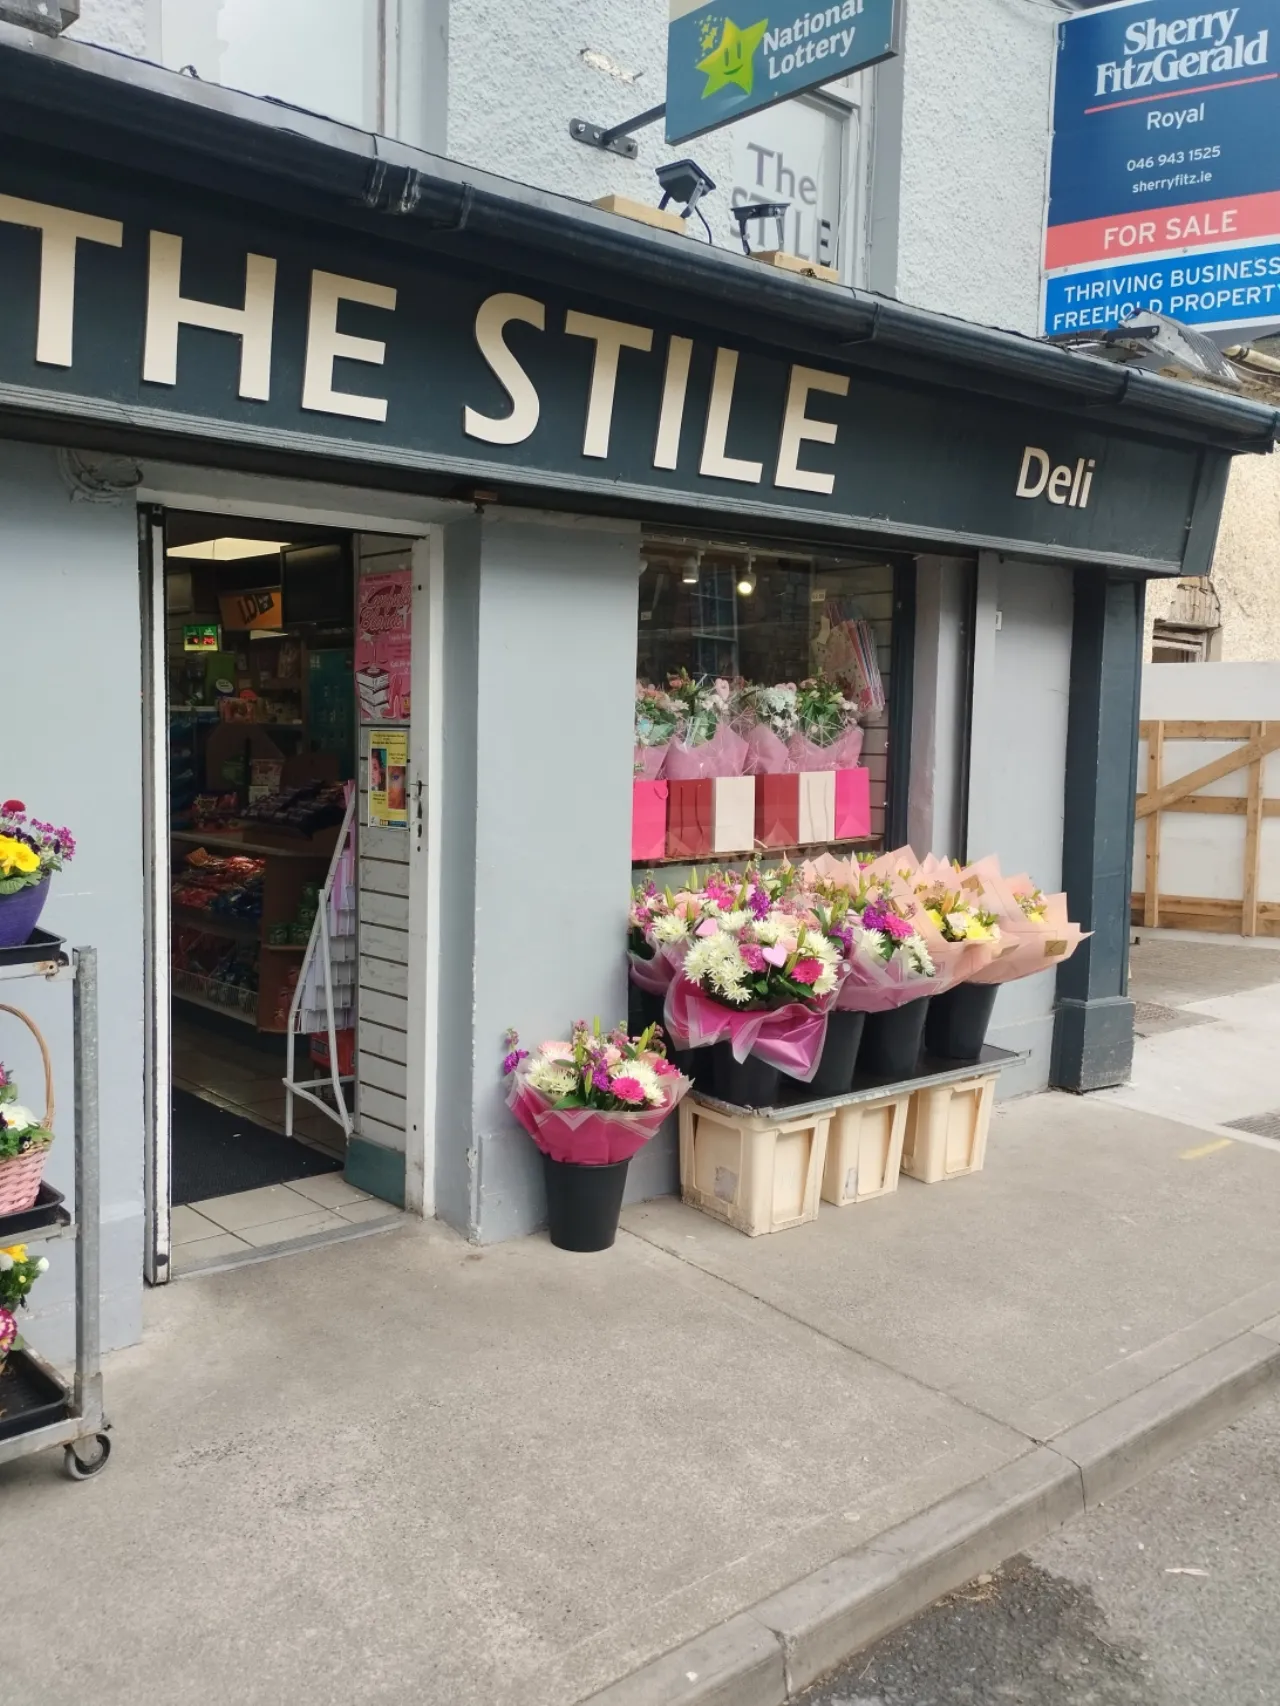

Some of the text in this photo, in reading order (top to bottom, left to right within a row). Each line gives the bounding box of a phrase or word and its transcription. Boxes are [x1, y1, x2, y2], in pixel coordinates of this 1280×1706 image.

[764, 0, 864, 55] National
[1123, 8, 1240, 55] Sherry
[769, 27, 856, 79] Lottery
[1094, 30, 1268, 97] FitzGerald
[1147, 103, 1205, 130] Royal
[747, 142, 817, 205] The
[1126, 145, 1221, 172] 046 943 1525
[1132, 170, 1213, 193] sherryfitz.ie
[1104, 209, 1238, 250] FOR SALE
[1064, 256, 1280, 304] THRIVING BUSINESS
[1170, 283, 1280, 314] PROPERT
[0, 192, 851, 495] THE STILE
[1015, 445, 1096, 509] Deli
